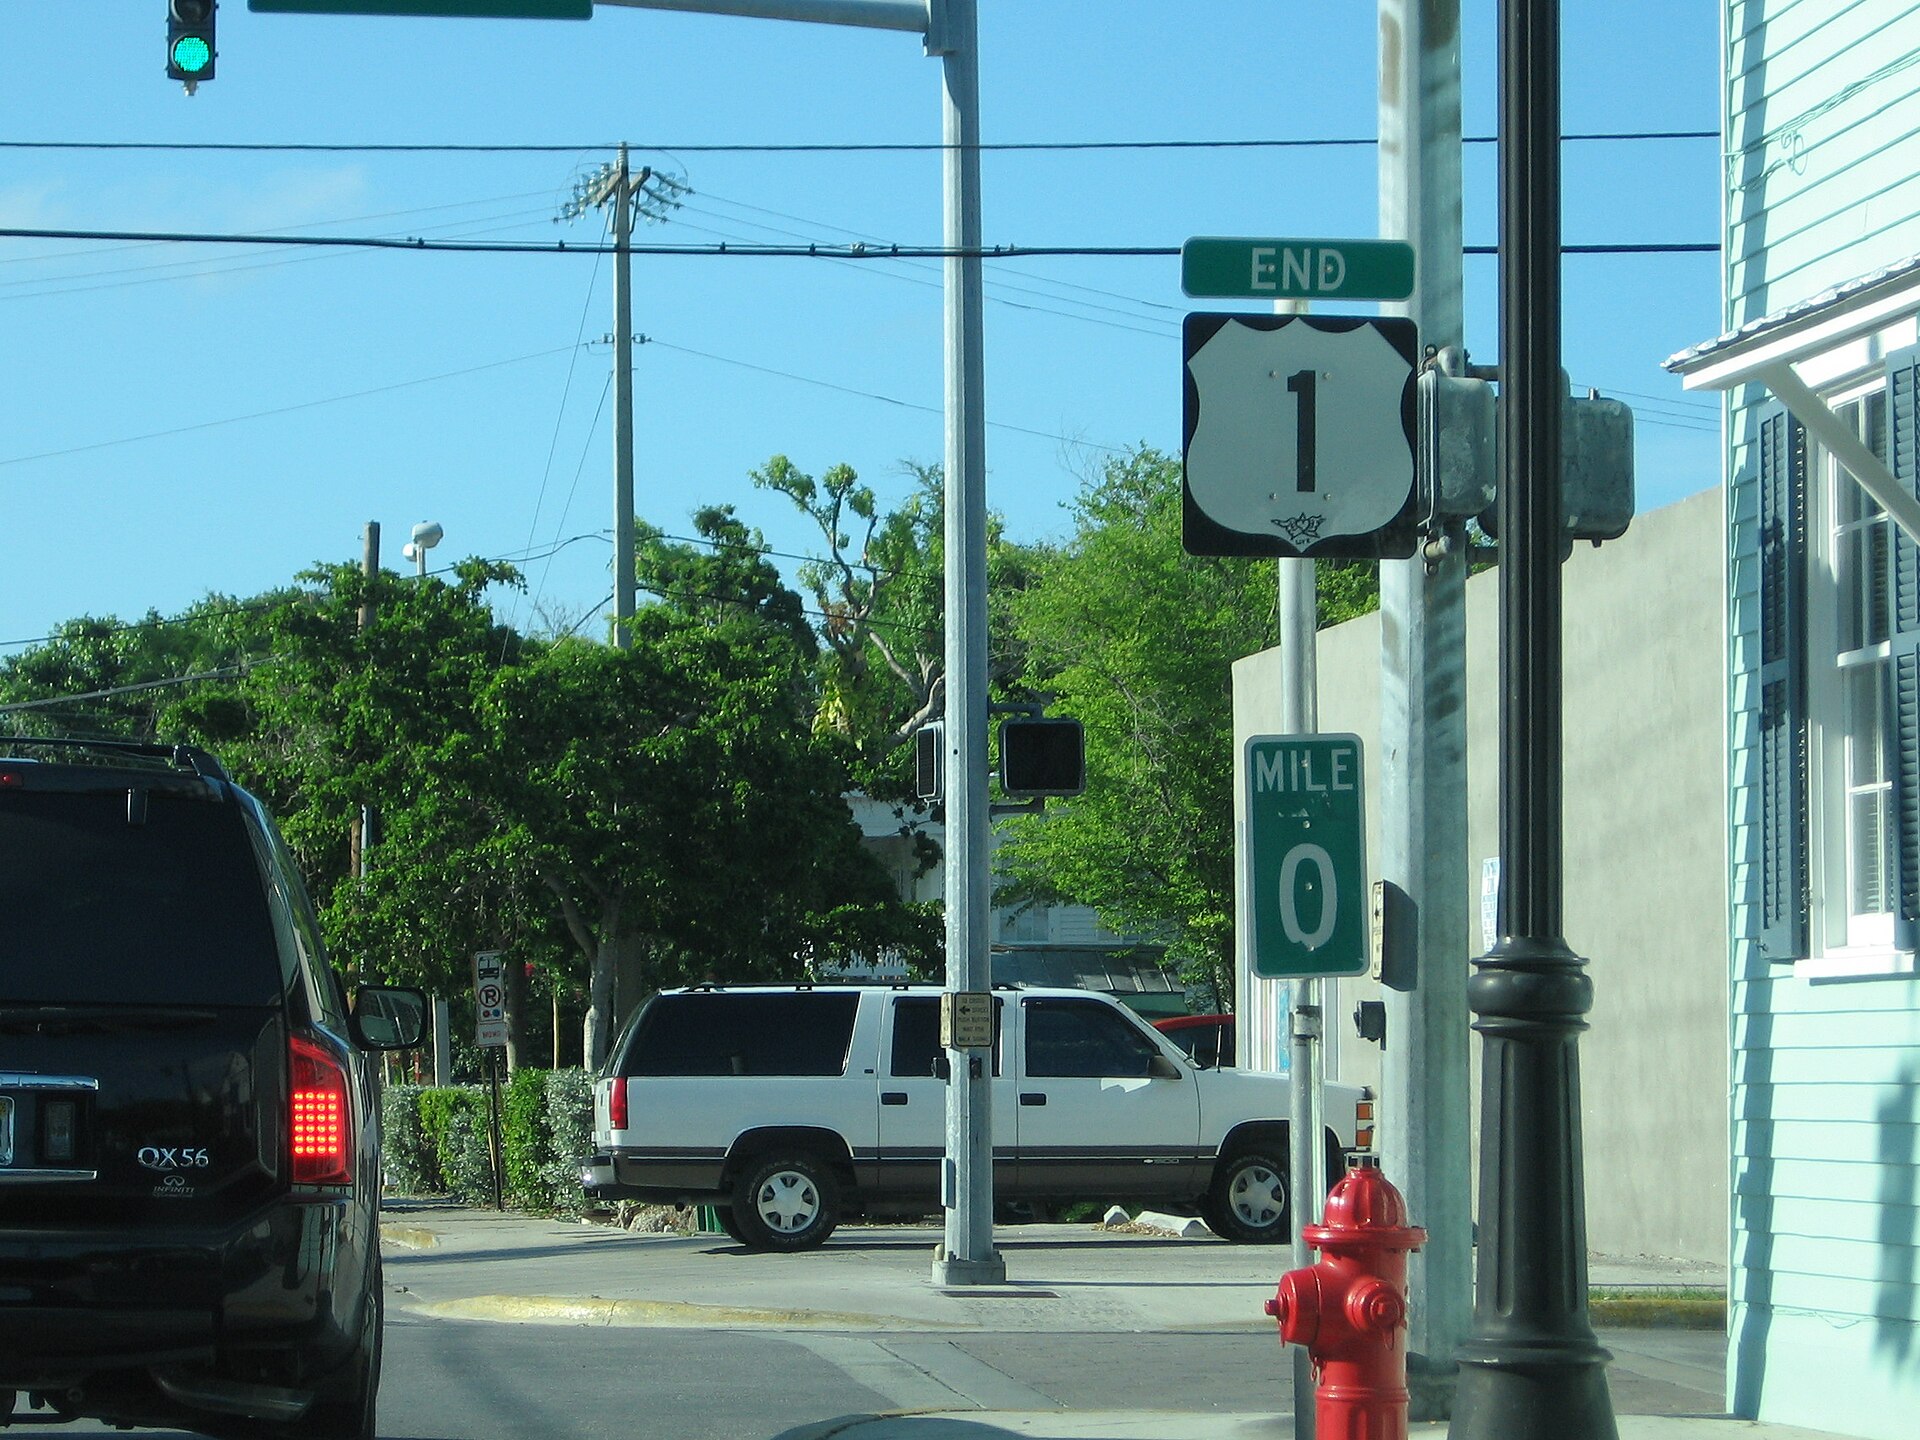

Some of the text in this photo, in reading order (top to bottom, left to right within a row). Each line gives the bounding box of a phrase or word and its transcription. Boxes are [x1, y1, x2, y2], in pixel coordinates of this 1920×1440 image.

[1251, 247, 1346, 291] END
[1287, 369, 1316, 493] 1
[1256, 748, 1354, 793] MILE
[1279, 842, 1338, 949] 0
